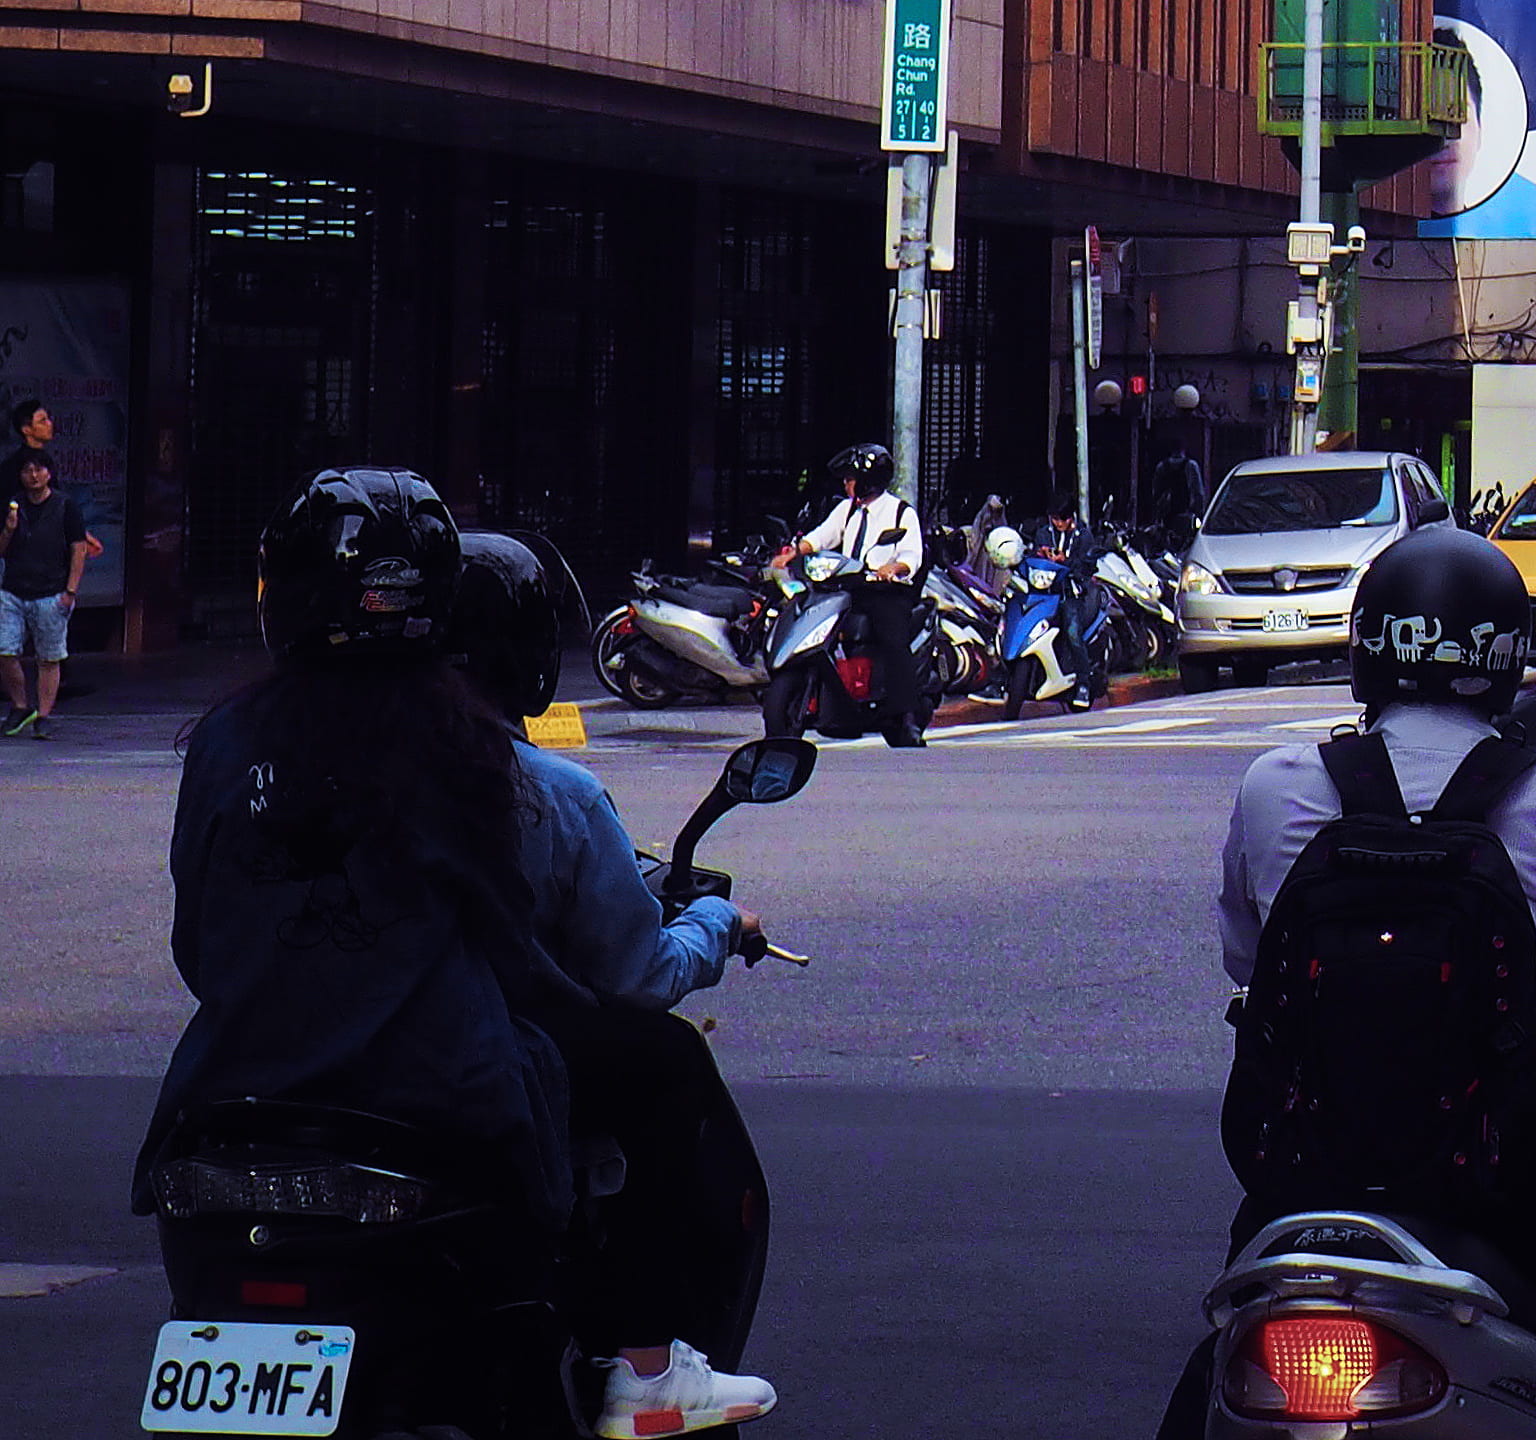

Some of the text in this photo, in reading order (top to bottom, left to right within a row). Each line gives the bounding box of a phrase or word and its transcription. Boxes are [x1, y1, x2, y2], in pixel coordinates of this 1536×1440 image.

[897, 54, 936, 71] Chang
[897, 69, 928, 83] Chun
[896, 82, 916, 96] Rd.
[896, 100, 911, 115] 27
[919, 101, 935, 115] 40
